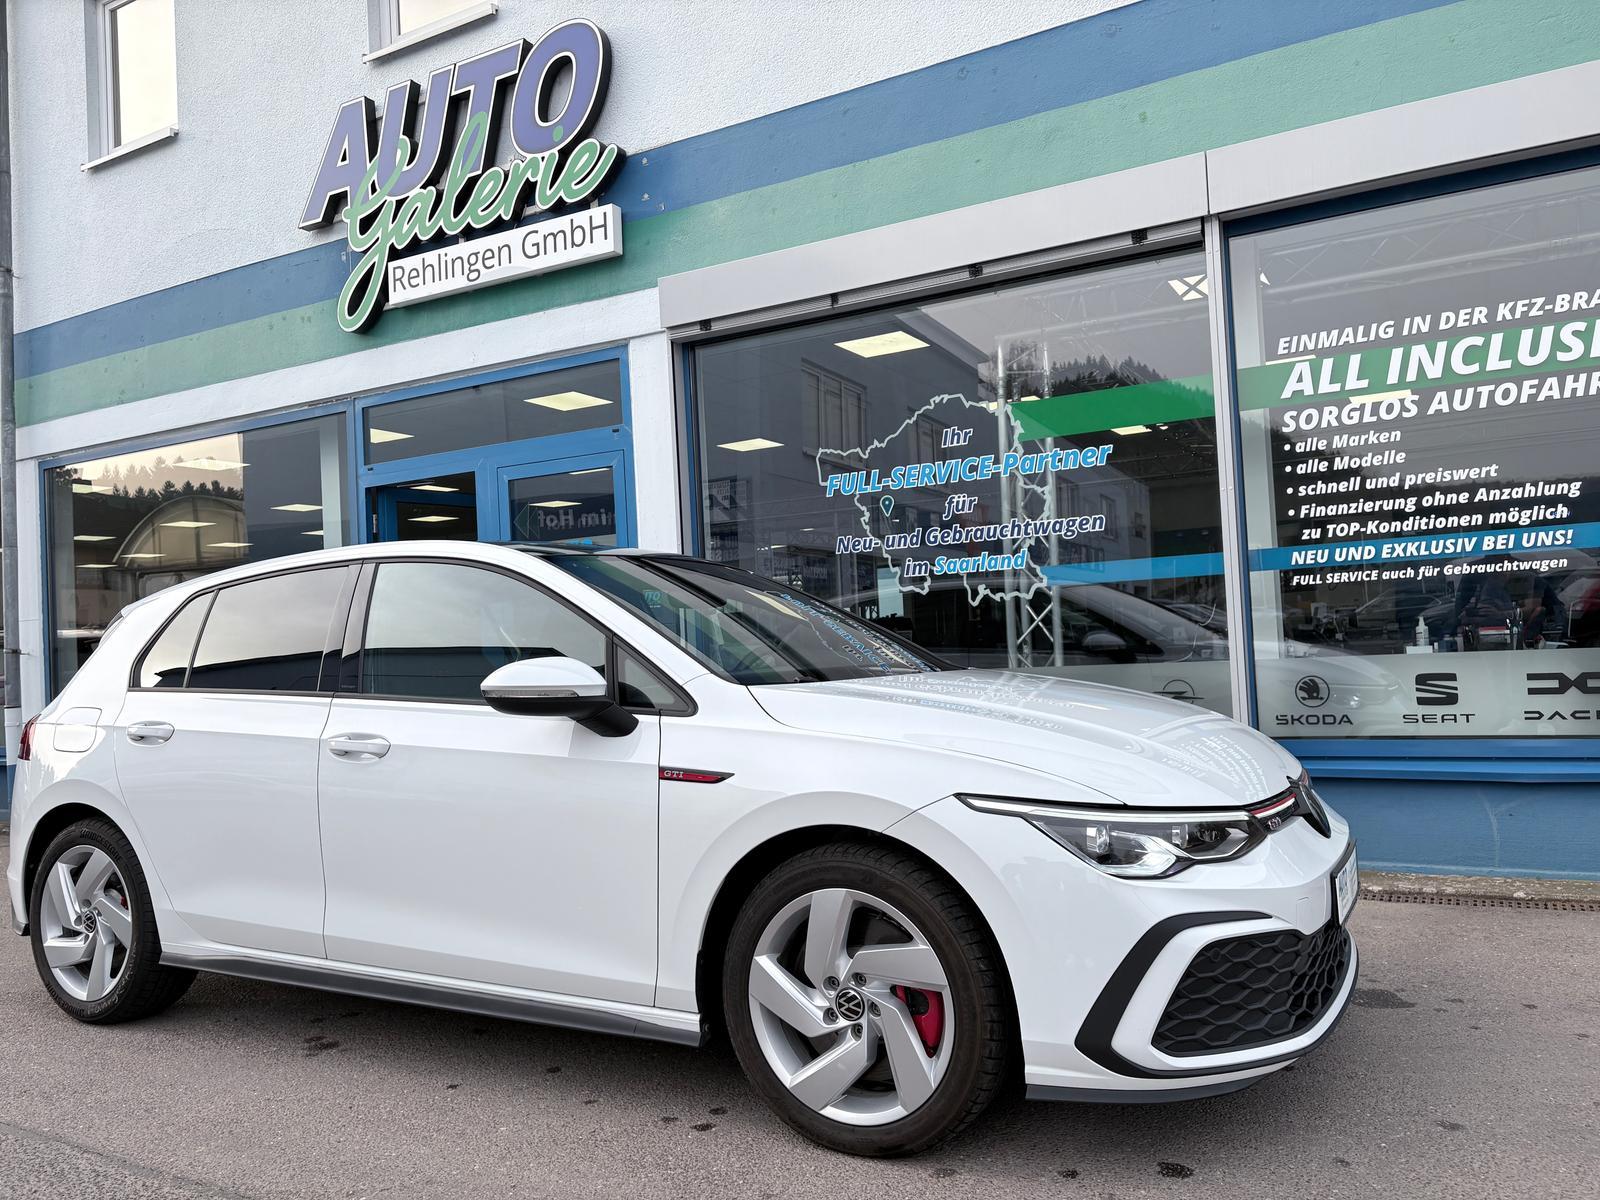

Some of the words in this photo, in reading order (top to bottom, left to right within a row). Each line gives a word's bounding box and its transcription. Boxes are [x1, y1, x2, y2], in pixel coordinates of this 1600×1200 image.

[299, 18, 606, 230] AUTO
[338, 111, 621, 332] Galerie
[392, 243, 512, 293] Rehlingen
[521, 211, 608, 260] GmbH
[1277, 320, 1395, 355] EINMALIG
[1402, 314, 1432, 336] IN
[1438, 306, 1489, 331] DER
[1496, 288, 1600, 322] KFZ-BRA
[1280, 353, 1370, 399] ALL
[1281, 395, 1419, 433] SORGLOS
[941, 426, 973, 448] Ihr
[1295, 437, 1328, 453] alle
[1332, 430, 1402, 449] Marken
[826, 444, 1113, 497] FULL-SERVICE-Partner
[1296, 458, 1329, 475] alle
[1333, 450, 1407, 471] Modelle
[1298, 476, 1361, 497] schnell
[1365, 472, 1400, 490] und
[1404, 463, 1499, 490] preiswert
[943, 494, 978, 520] für
[1299, 495, 1418, 518] Finanzierung
[1421, 491, 1470, 507] ohne
[1474, 481, 1582, 503] Anzahlung
[835, 536, 881, 554] Neu-
[884, 528, 922, 550] und
[925, 515, 1106, 547] Gebrauchtwagen
[1301, 527, 1322, 540] zu
[1326, 512, 1483, 538] TOP-Konditionen
[1488, 503, 1569, 526] möglich
[904, 558, 930, 577] im
[934, 548, 1028, 575] Saarland
[1291, 548, 1329, 565] NEU
[1334, 545, 1376, 562] UND
[1381, 536, 1478, 559] EXKLUSIV
[1482, 533, 1516, 551] BEI
[1521, 529, 1574, 548] UNS!
[1292, 575, 1323, 586] FULL
[1325, 569, 1379, 584] SERVICE
[1382, 567, 1415, 580] auch
[1416, 565, 1440, 580] für
[1443, 558, 1568, 576] Gebrauchtwagen
[1402, 713, 1476, 724] SEAT
[663, 769, 685, 779] GTI
